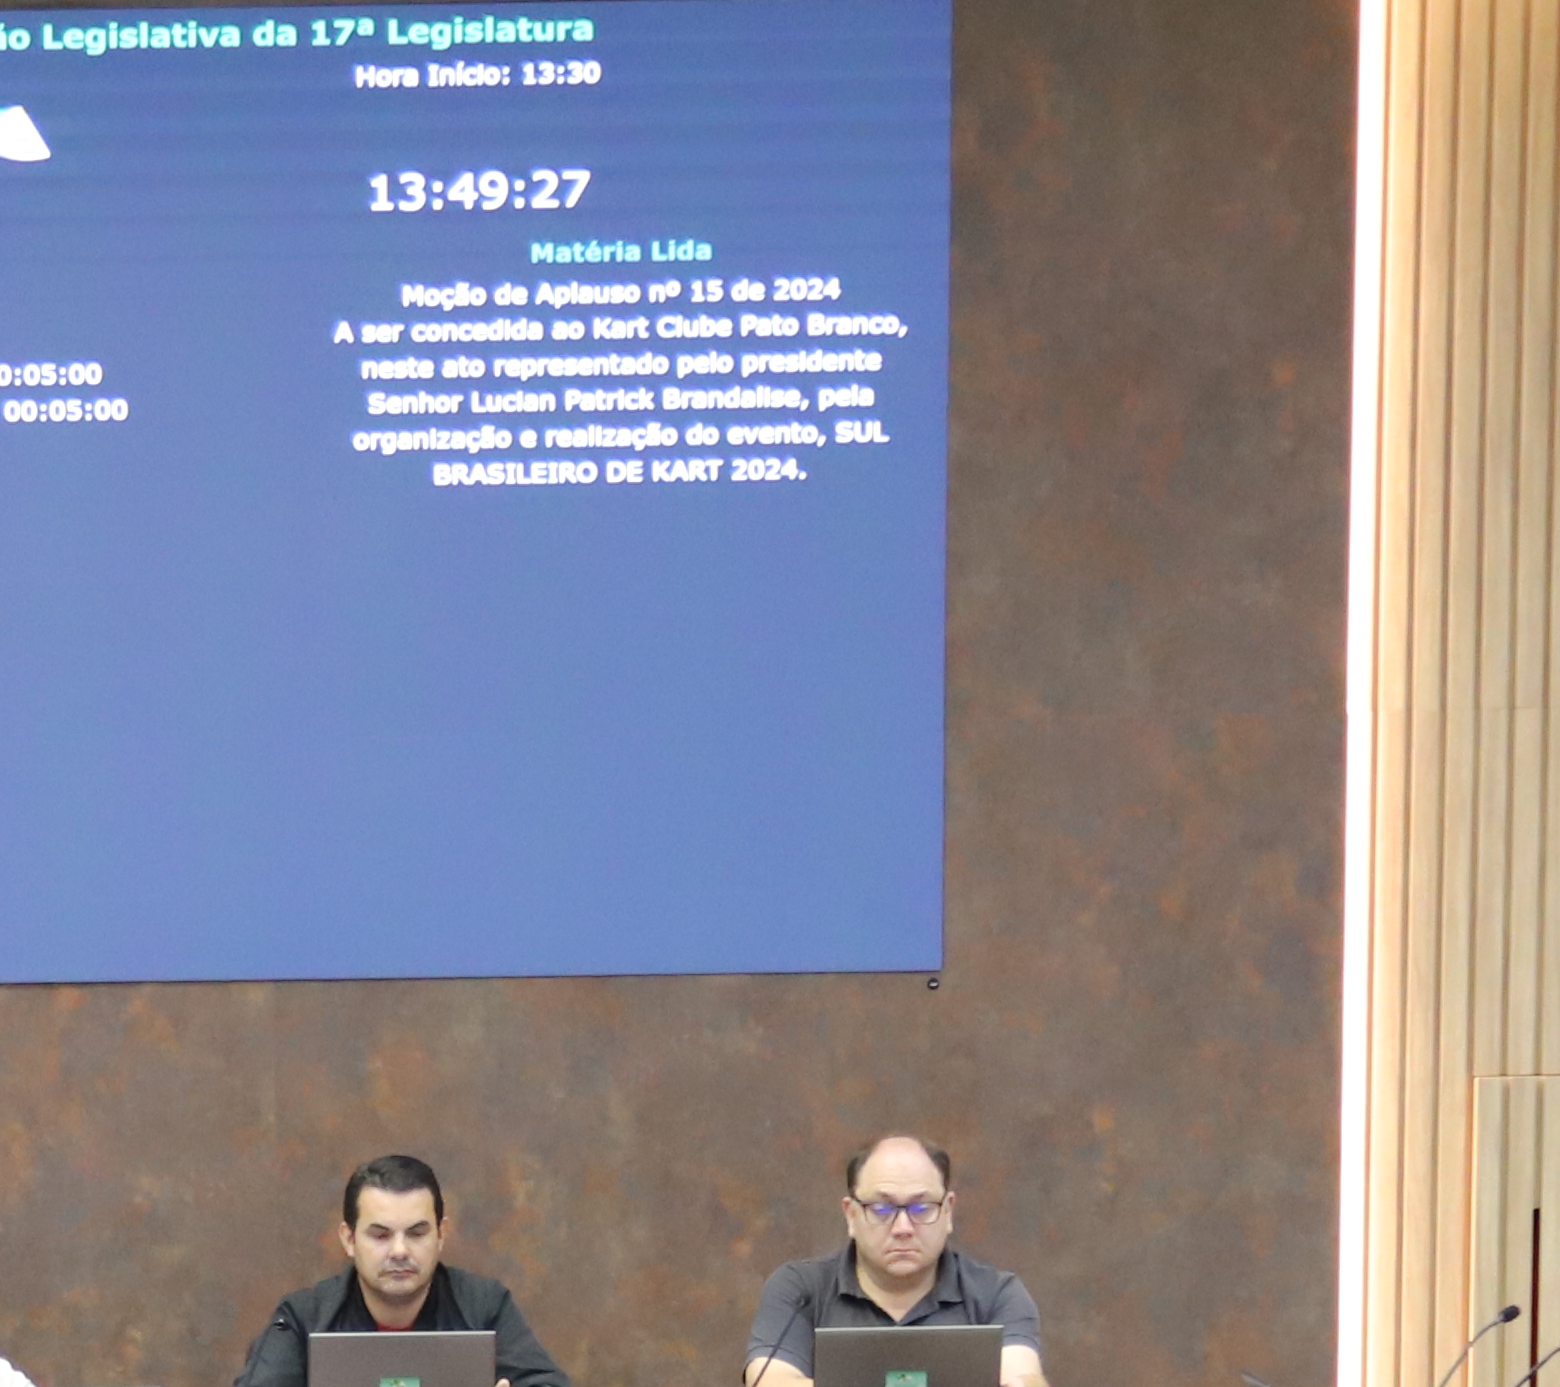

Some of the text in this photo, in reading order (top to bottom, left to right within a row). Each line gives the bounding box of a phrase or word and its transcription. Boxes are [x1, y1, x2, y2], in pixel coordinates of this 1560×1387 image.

[43, 21, 241, 56] Legislativa
[252, 19, 297, 47] da
[311, 18, 374, 46] 17ª
[388, 16, 593, 50] Legislatura
[355, 61, 601, 88] Hora Início: 13:30
[370, 169, 591, 212] 13:49:27
[531, 239, 712, 264] Matéria Lida
[402, 277, 841, 311] Moção de Aplauso nº 15 de 2024
[334, 313, 908, 344] A ser concedida ao Kart Clube Pato Branco,
[361, 349, 882, 382] neste ato representado pelo presidente
[3, 398, 129, 423] 00:05:00
[368, 384, 875, 415] Senhor Lucian Patrick Brandalise, pela
[352, 420, 890, 455] organização e realização do evento, SUL
[433, 458, 807, 486] BRASILEIRO DE KART 2024.
